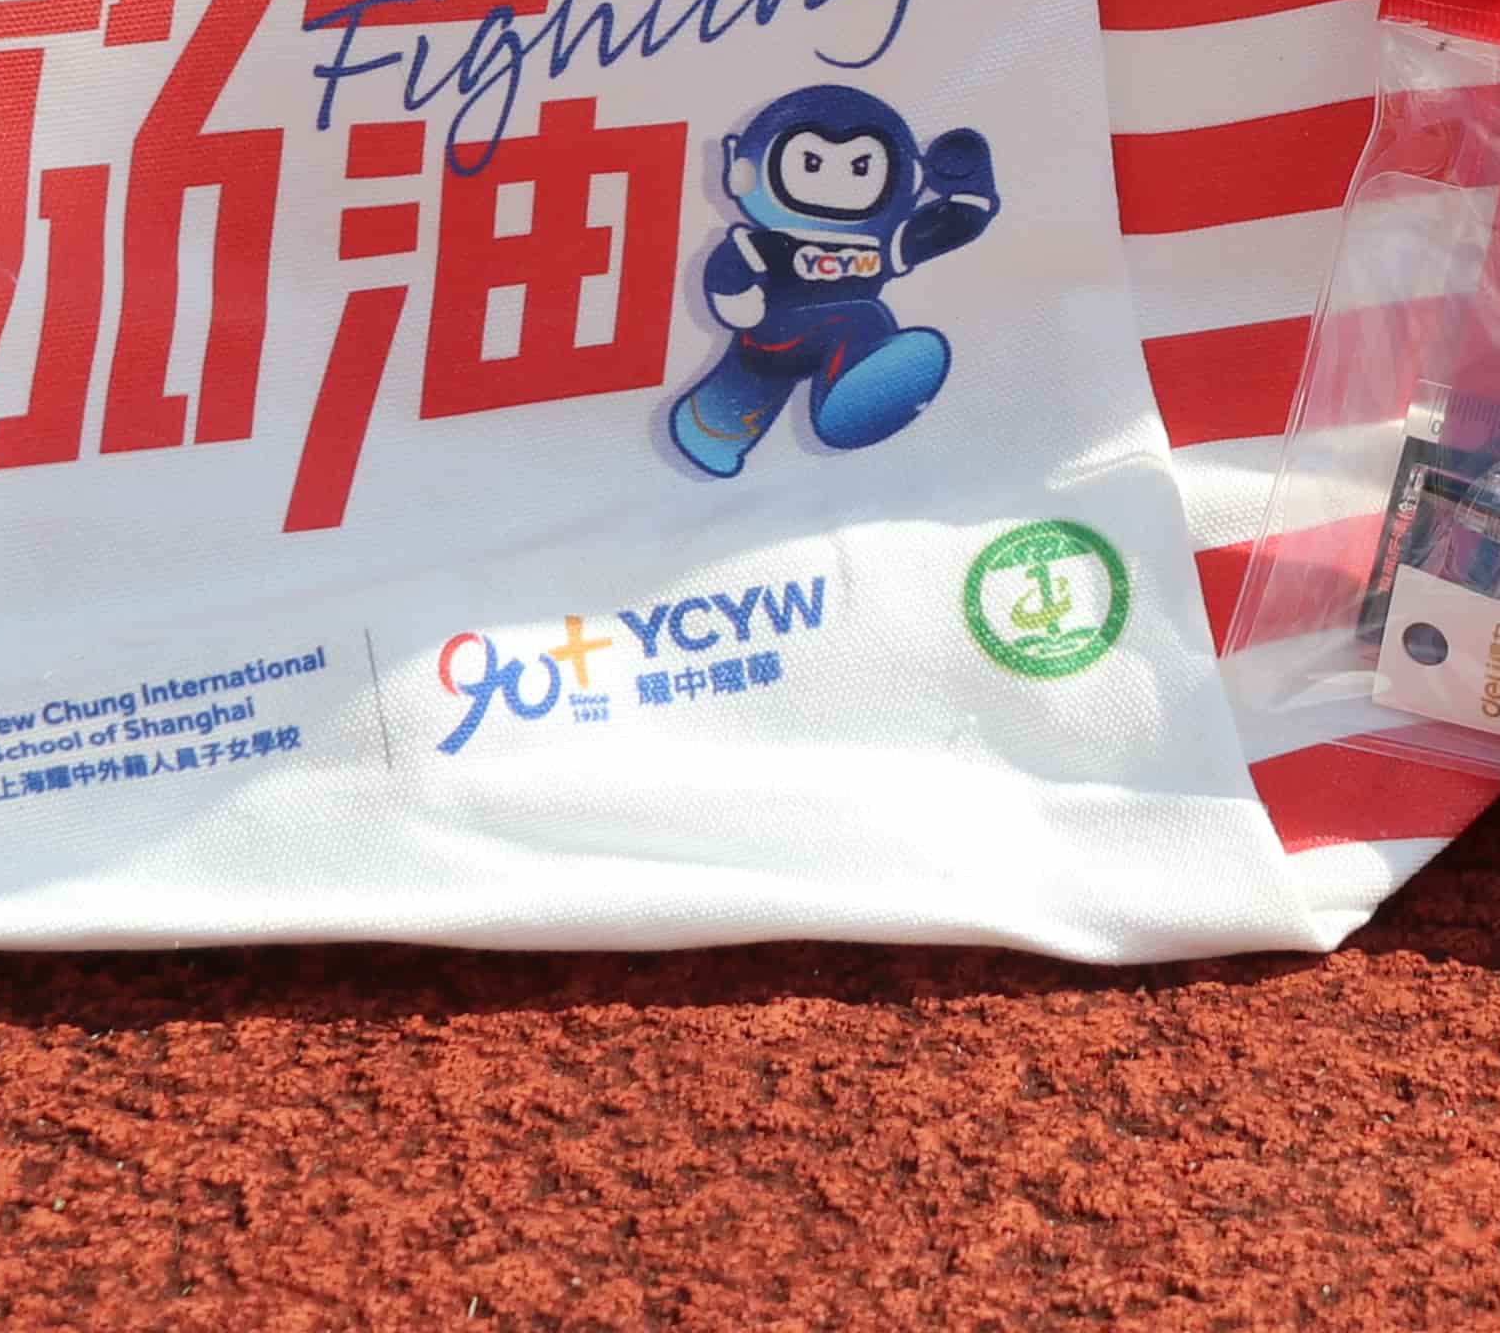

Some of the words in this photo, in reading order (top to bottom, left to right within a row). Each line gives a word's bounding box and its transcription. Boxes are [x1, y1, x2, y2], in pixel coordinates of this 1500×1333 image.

[801, 252, 879, 275] YCYW
[616, 576, 827, 659] YCYW
[41, 689, 136, 726] Chung
[142, 646, 328, 707] International
[89, 722, 120, 748] of
[122, 695, 257, 741] Shanghai
